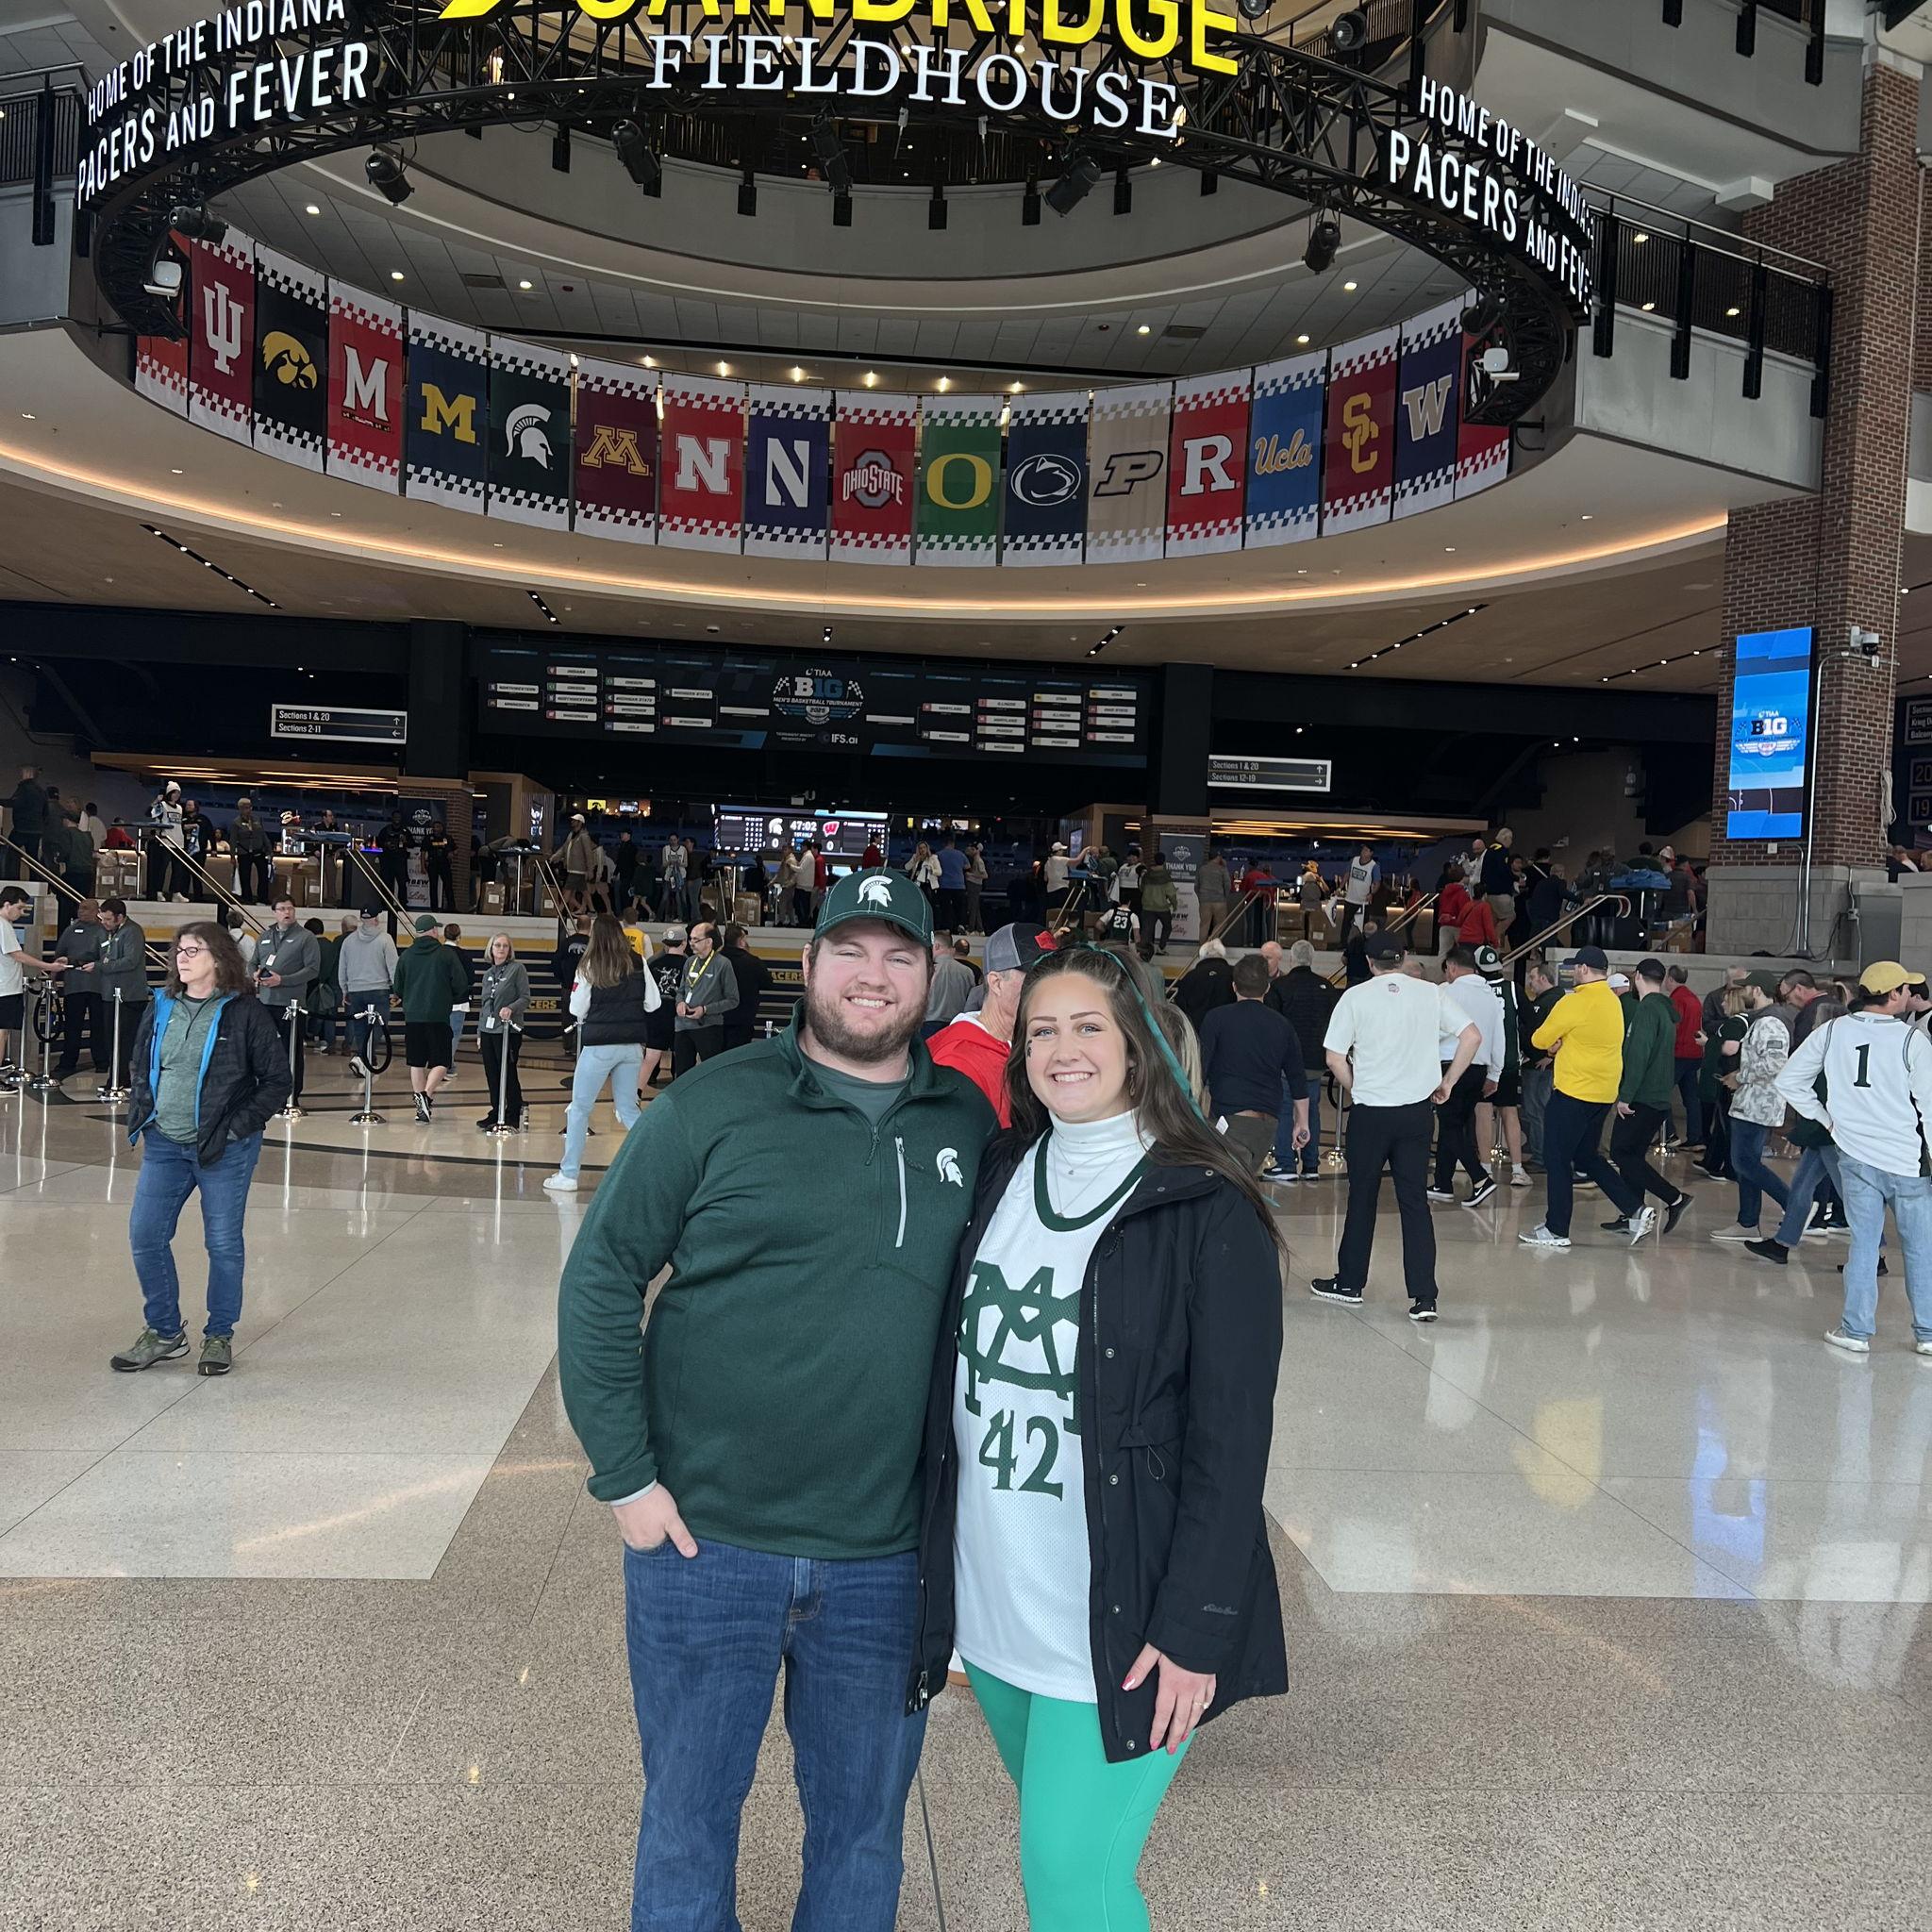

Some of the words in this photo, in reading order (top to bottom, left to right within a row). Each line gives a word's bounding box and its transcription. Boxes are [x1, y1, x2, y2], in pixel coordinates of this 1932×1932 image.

[88, 60, 128, 126] HOME
[133, 42, 157, 91] OF
[162, 19, 207, 74] THE
[645, 34, 1178, 139] FIELDHOUSE
[77, 108, 156, 209] PACERS
[166, 97, 214, 151] AND
[229, 42, 368, 128] FEVER
[1419, 75, 1491, 148] HOME
[1495, 118, 1521, 164] OF
[1525, 138, 1557, 194] THE
[1390, 129, 1518, 242] PACERS
[1525, 219, 1557, 272] AND
[1560, 234, 1592, 314] FEV
[421, 382, 476, 444] M
[1403, 374, 1453, 441] W
[674, 433, 731, 495] N
[765, 437, 810, 508] N
[1092, 450, 1164, 497] P
[1180, 434, 1237, 497] R
[278, 710, 308, 720] Sections
[312, 711, 320, 721] &
[320, 712, 330, 721] 20
[278, 723, 308, 733] Sections
[308, 724, 322, 733] 2-11
[831, 733, 858, 744] IFS.ai
[1211, 772, 1239, 781] Sections
[1239, 774, 1257, 782] 12-19
[1212, 760, 1239, 770] Sections
[1250, 762, 1259, 771] 20
[790, 821, 817, 831] 47:02
[1165, 862, 1185, 871] THANK
[1185, 863, 1197, 872] YOU
[1113, 915, 1128, 929] 23
[771, 972, 804, 981] ACERS
[528, 1000, 558, 1009] CERS
[1853, 1042, 1872, 1088] 1
[978, 1408, 1064, 1502] 42
